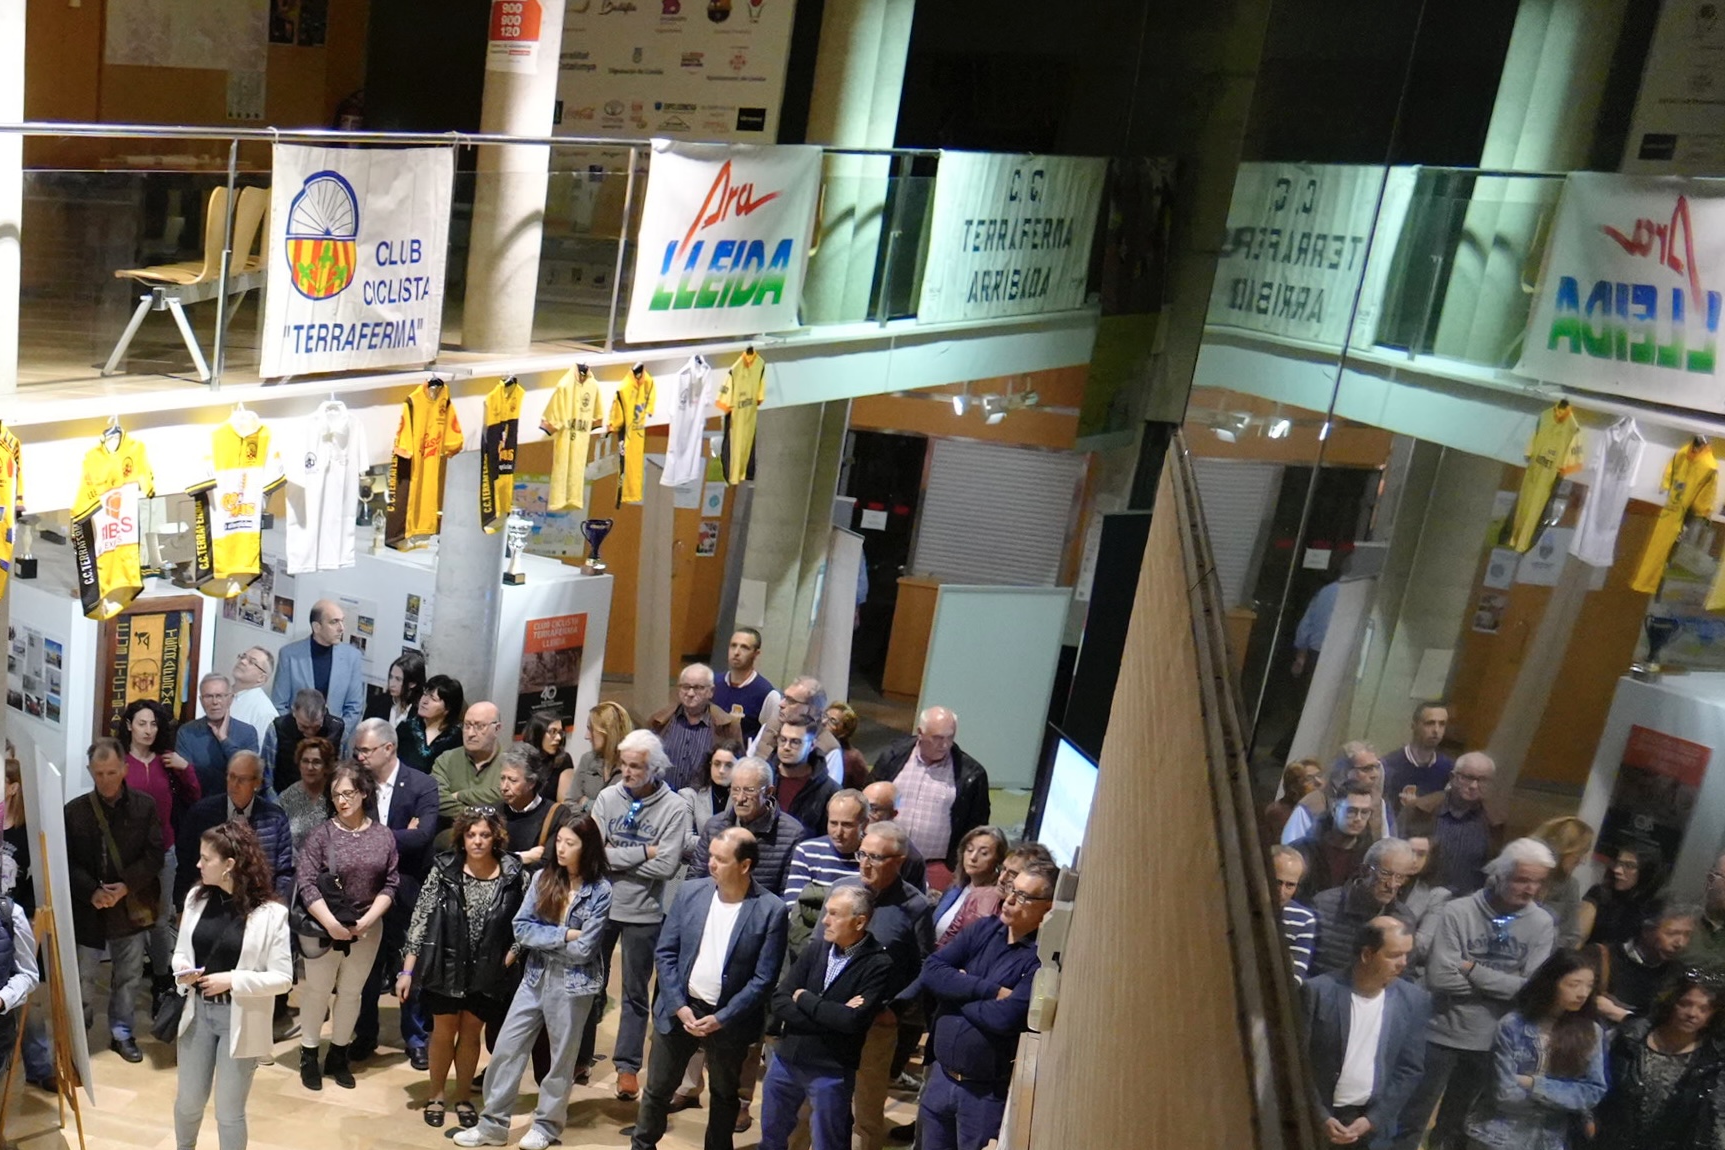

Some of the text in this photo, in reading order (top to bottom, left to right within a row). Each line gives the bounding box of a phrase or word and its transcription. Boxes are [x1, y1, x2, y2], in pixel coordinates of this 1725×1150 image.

[500, 15, 521, 26] 900
[502, 3, 522, 14] 900
[500, 27, 520, 37] 120
[962, 218, 1074, 254] TERRAFERMA
[376, 239, 422, 267] CLUB
[648, 238, 793, 312] LLEIDA
[966, 268, 1052, 303] ARRIBADA
[363, 276, 429, 306] CICLISTA
[284, 319, 424, 354] "TERRAFERMA"
[116, 623, 130, 656] CLUB
[161, 629, 179, 705] TERRAFERMA
[540, 685, 557, 700] 40
